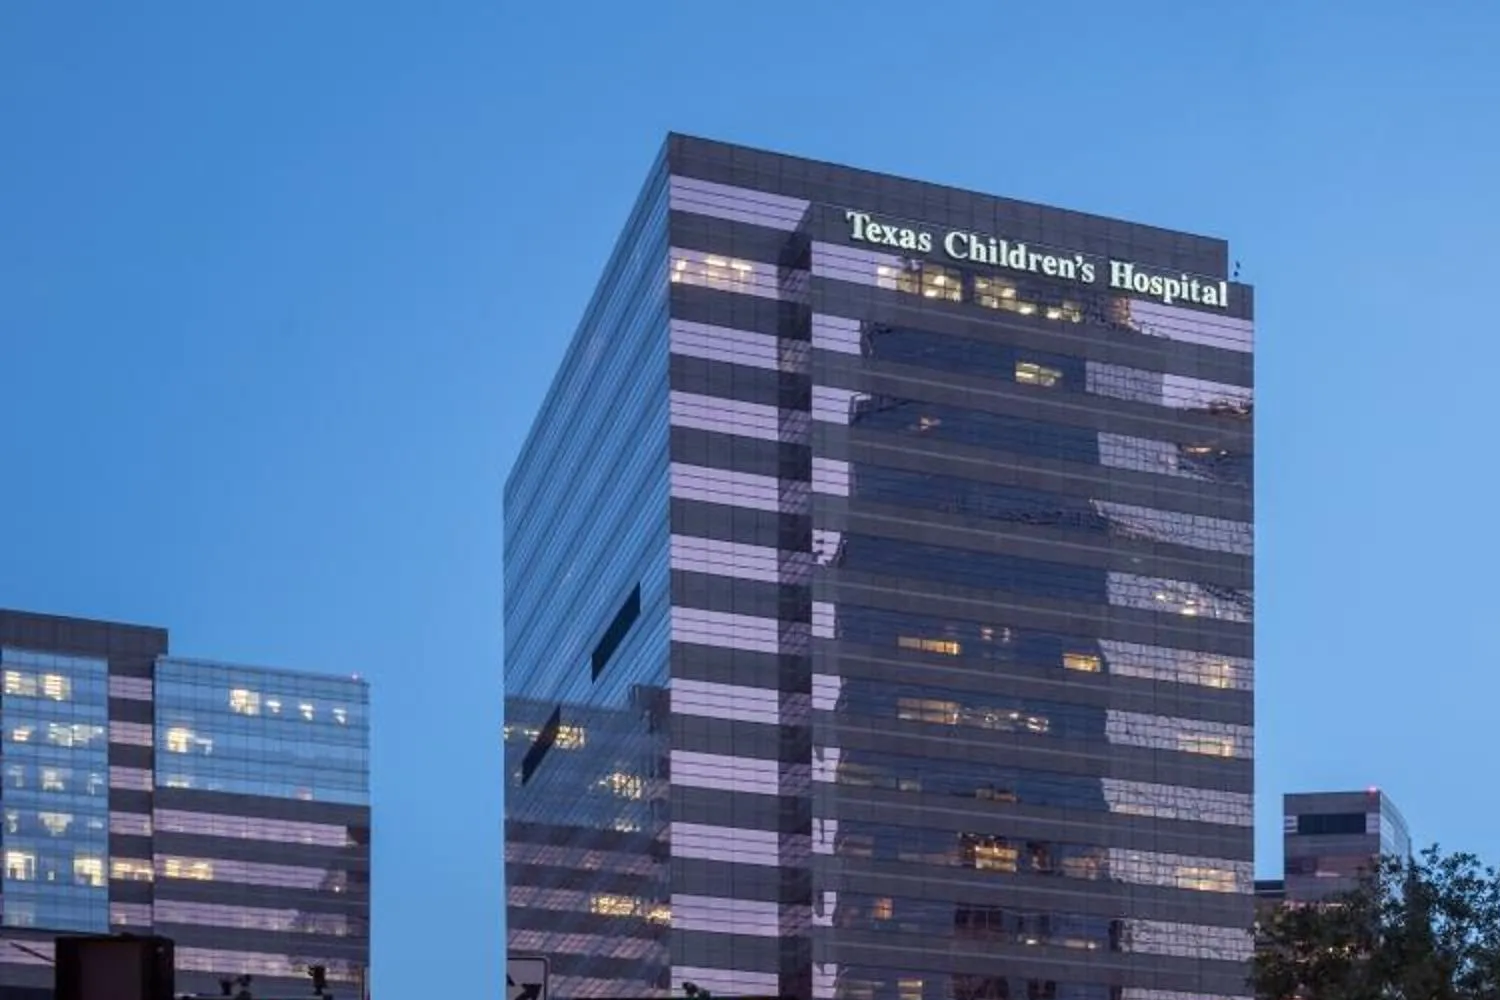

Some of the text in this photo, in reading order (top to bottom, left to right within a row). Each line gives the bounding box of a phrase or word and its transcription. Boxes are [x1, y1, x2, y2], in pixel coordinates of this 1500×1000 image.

[845, 211, 1229, 308] Texas Children's Hospital
